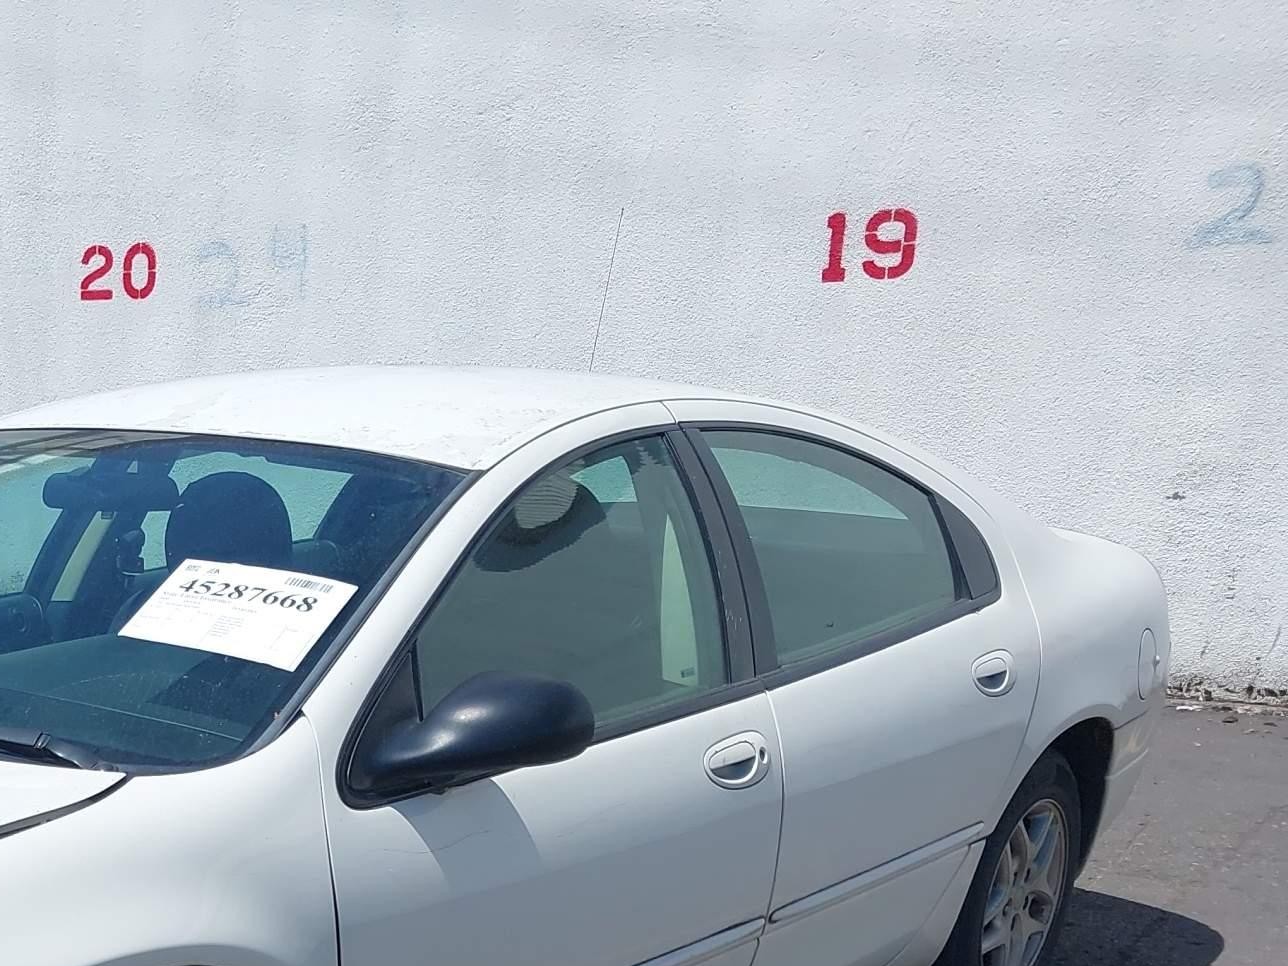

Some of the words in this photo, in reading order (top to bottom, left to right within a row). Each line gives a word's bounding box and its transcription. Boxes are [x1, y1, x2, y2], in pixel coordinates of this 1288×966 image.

[80, 242, 156, 300] 20
[822, 208, 918, 283] 19
[179, 578, 318, 613] 45287668
